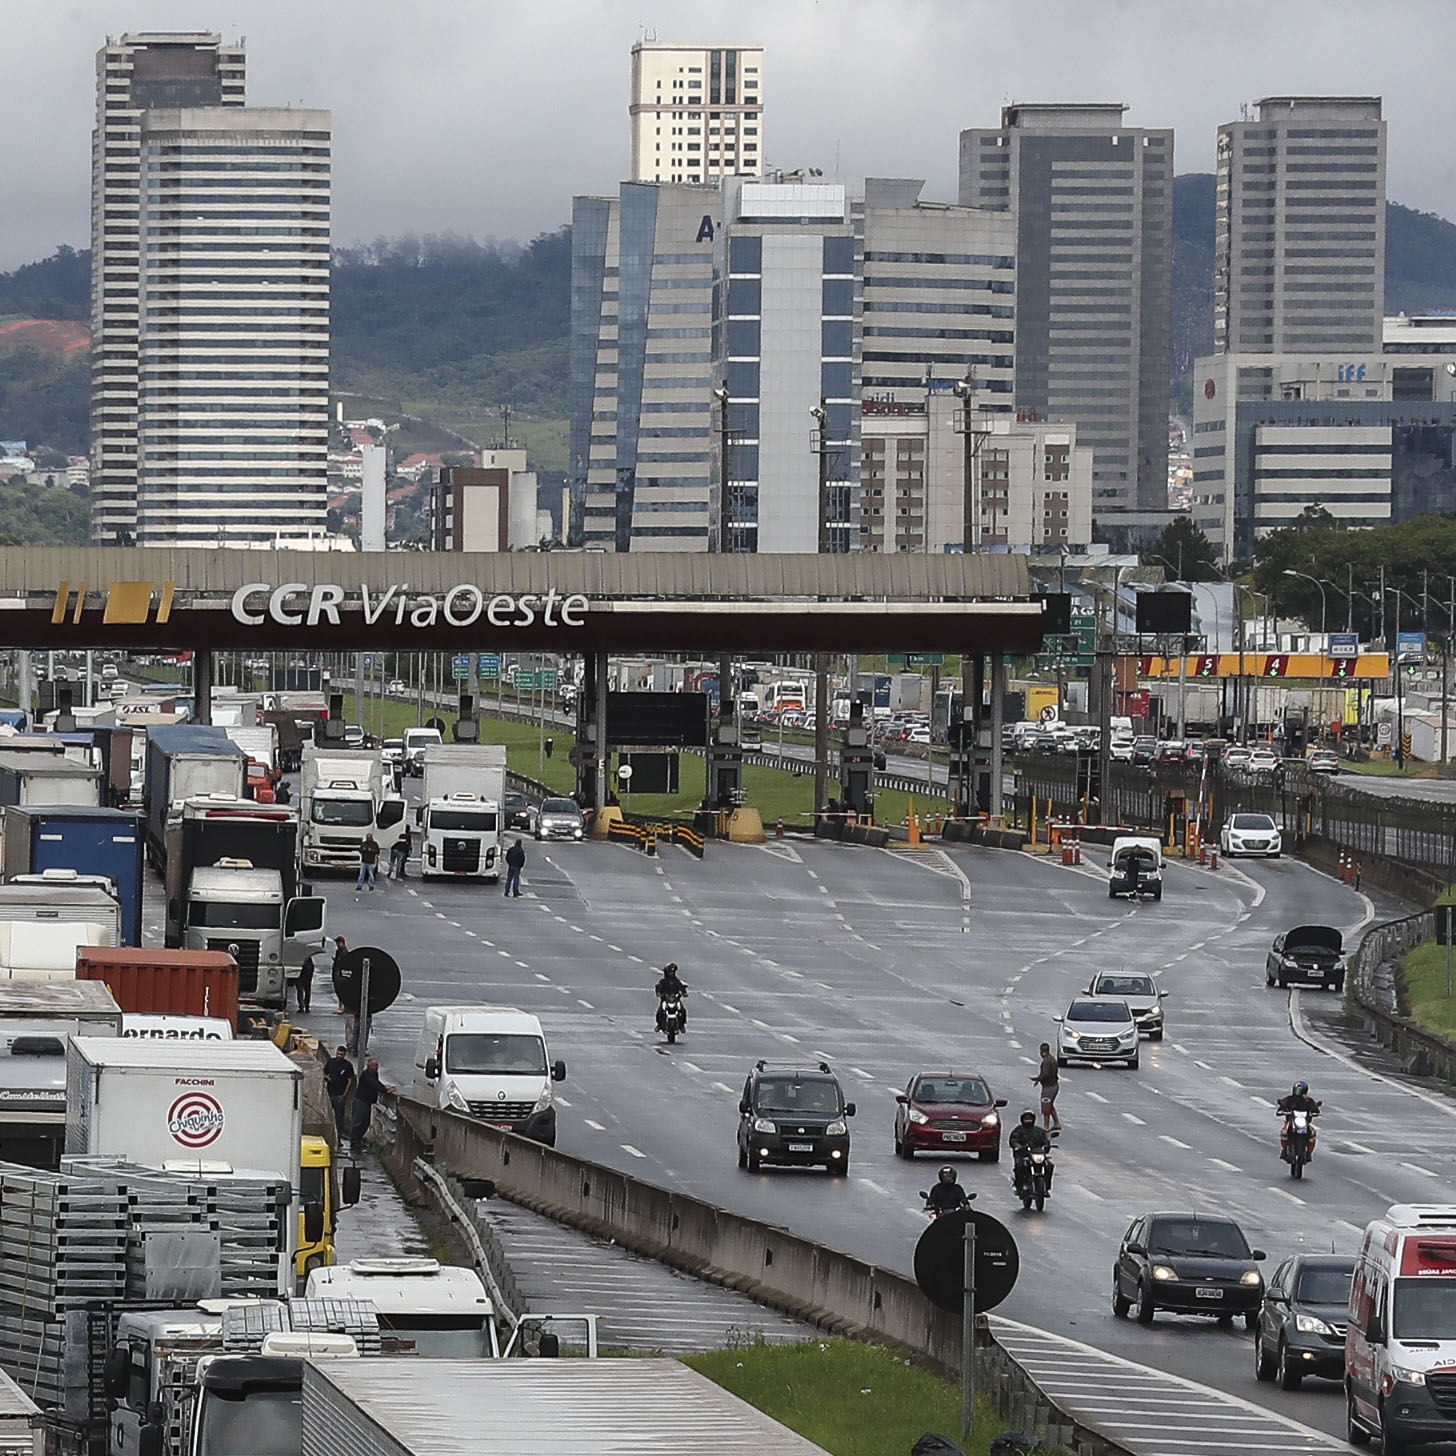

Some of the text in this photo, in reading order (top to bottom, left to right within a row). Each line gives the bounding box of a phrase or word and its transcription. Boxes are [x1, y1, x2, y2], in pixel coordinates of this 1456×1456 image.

[1337, 363, 1366, 384] iff
[231, 583, 589, 627] CCR ViaOeste
[1204, 659, 1213, 669] 5
[1270, 659, 1280, 669] 4
[1338, 659, 1347, 669] 3
[599, 760, 606, 769] E
[175, 1078, 215, 1086] FACCHINI
[169, 1111, 224, 1134] Chiquinho
